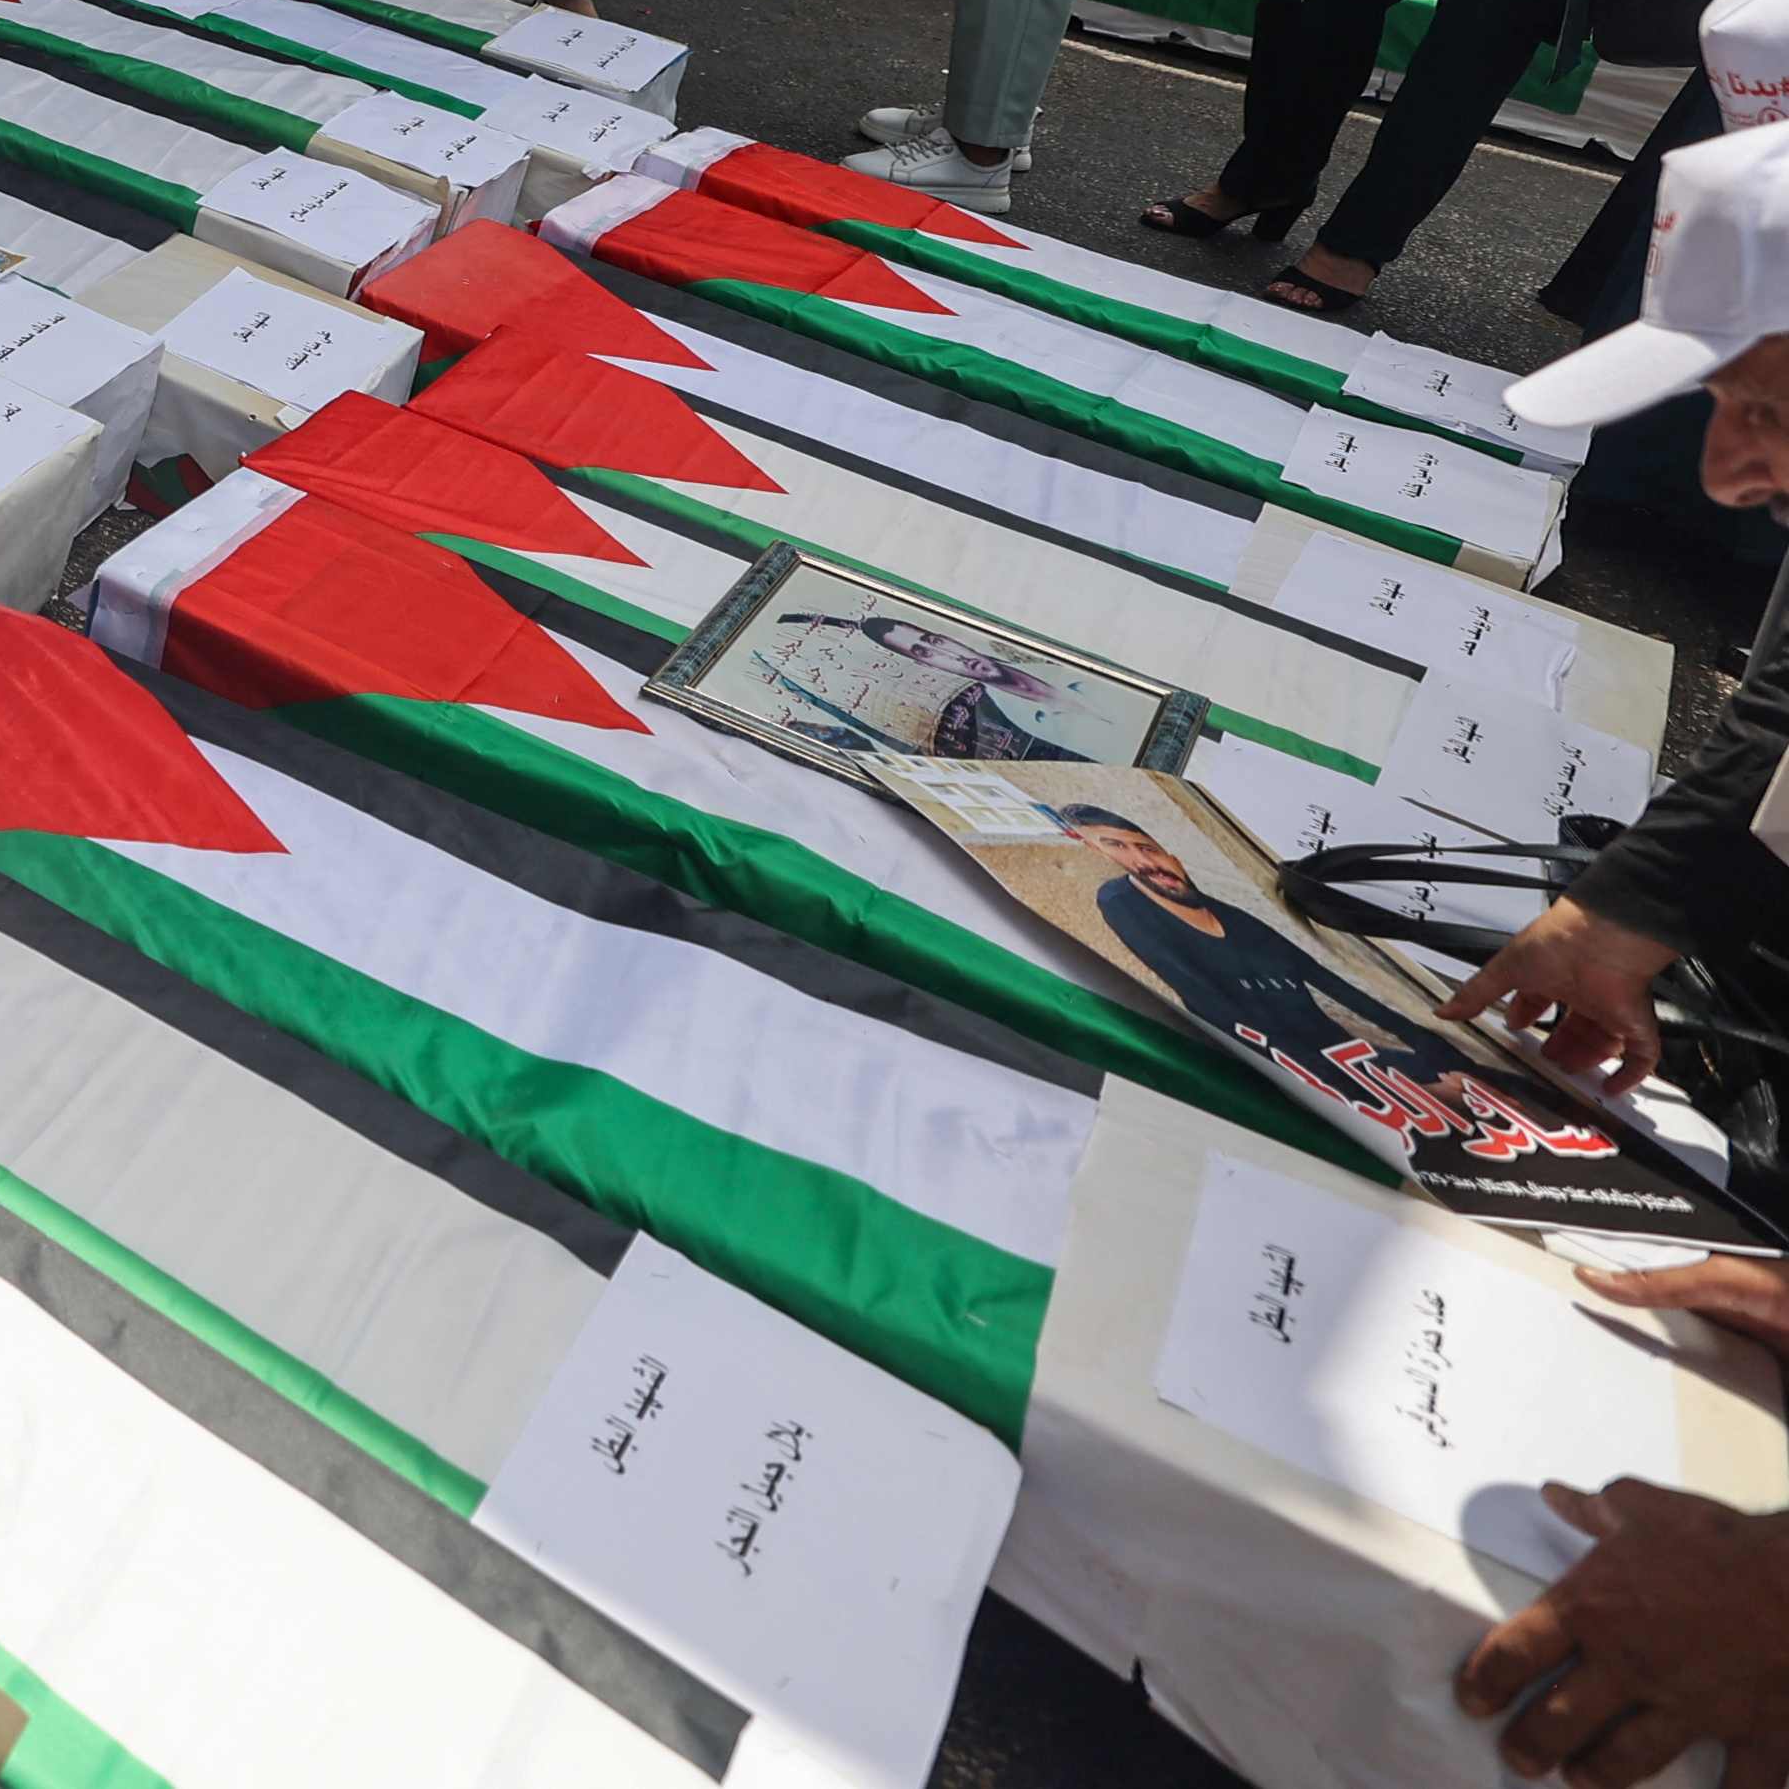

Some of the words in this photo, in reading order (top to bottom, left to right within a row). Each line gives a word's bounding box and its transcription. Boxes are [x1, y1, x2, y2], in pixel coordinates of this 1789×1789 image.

[1311, 806, 1336, 834] الشهيد
[1463, 1076, 1620, 1162] سائد
[1267, 1247, 1303, 1293] الشهيد
[1251, 1296, 1293, 1343] البطل
[626, 1357, 666, 1419] الشهيد
[593, 1419, 637, 1474] البطل
[774, 1422, 812, 1462] بلال
[753, 1457, 787, 1513] جميل
[720, 1509, 759, 1576] النجار
